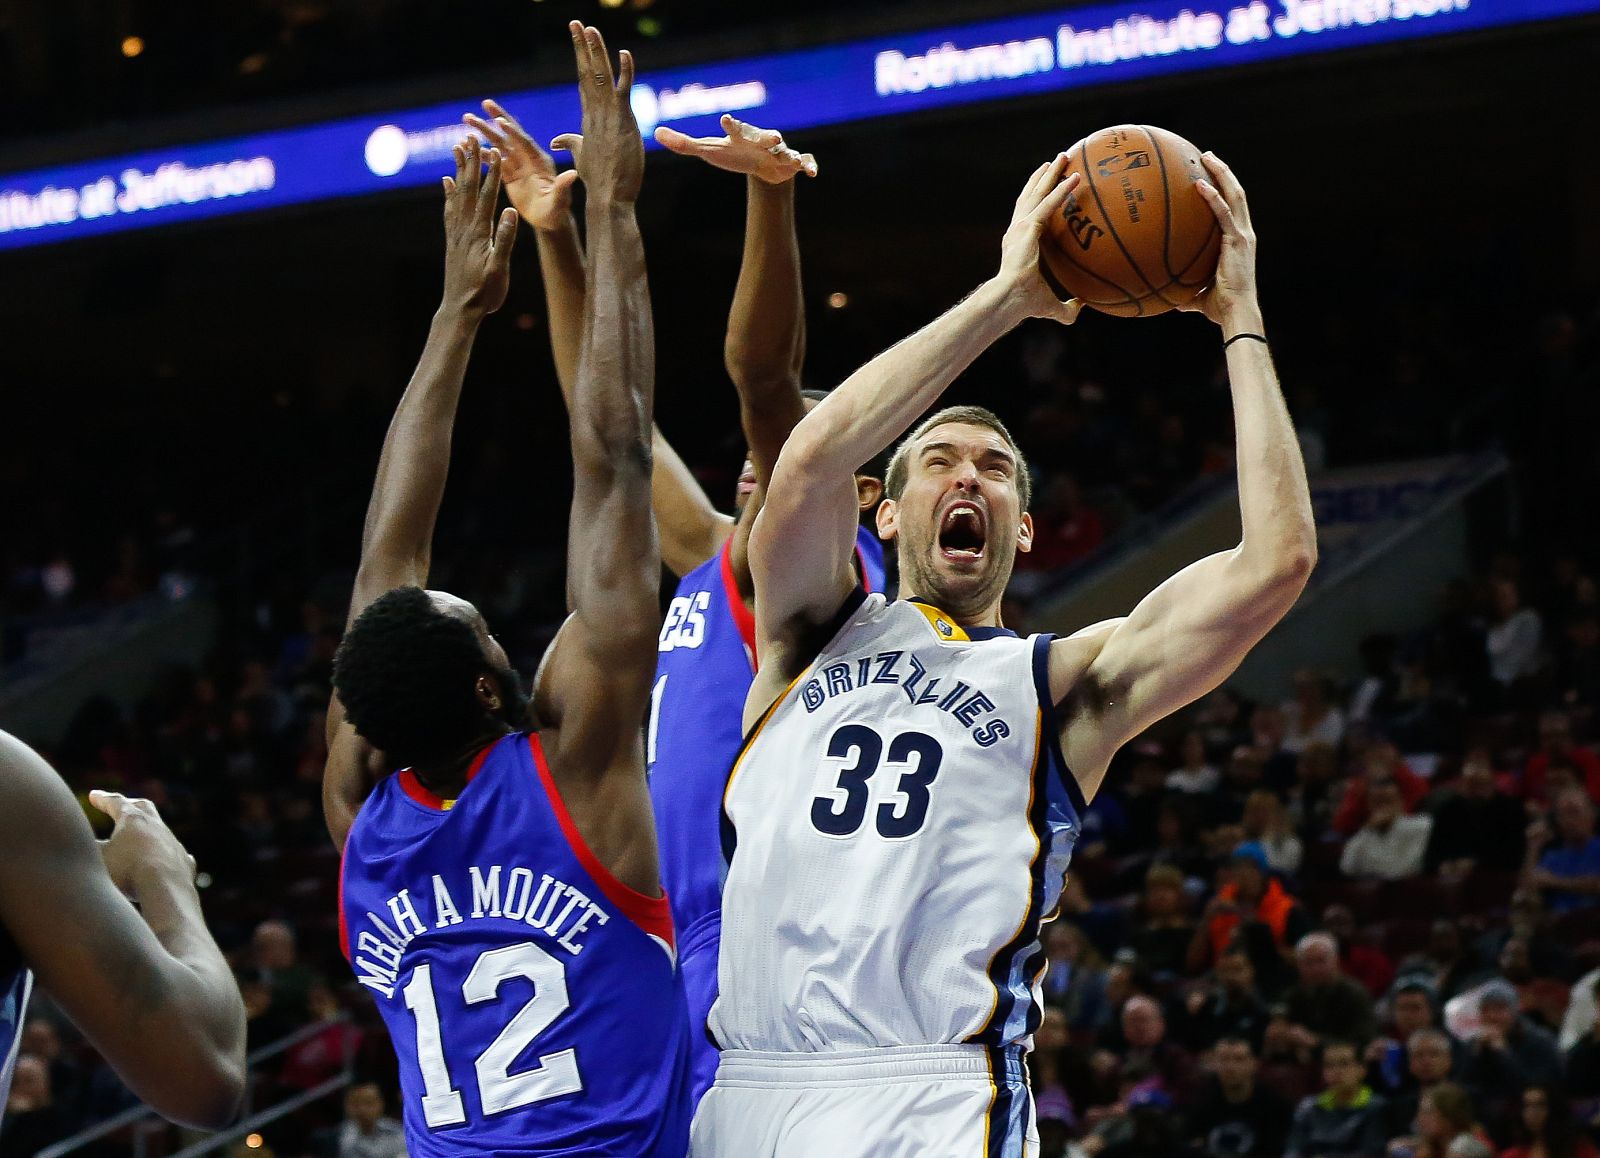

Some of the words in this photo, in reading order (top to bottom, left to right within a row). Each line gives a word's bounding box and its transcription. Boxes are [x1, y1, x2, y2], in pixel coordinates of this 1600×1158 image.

[875, 39, 1053, 94] Rothman
[1057, 14, 1222, 68] Institute
[1226, 6, 1270, 44] at
[801, 649, 1011, 748] GRIZZLIES
[809, 723, 944, 840] 33
[355, 888, 427, 1000] MBAH
[432, 874, 464, 929] A
[468, 865, 611, 956] MOUTE
[402, 941, 584, 1129] 12
